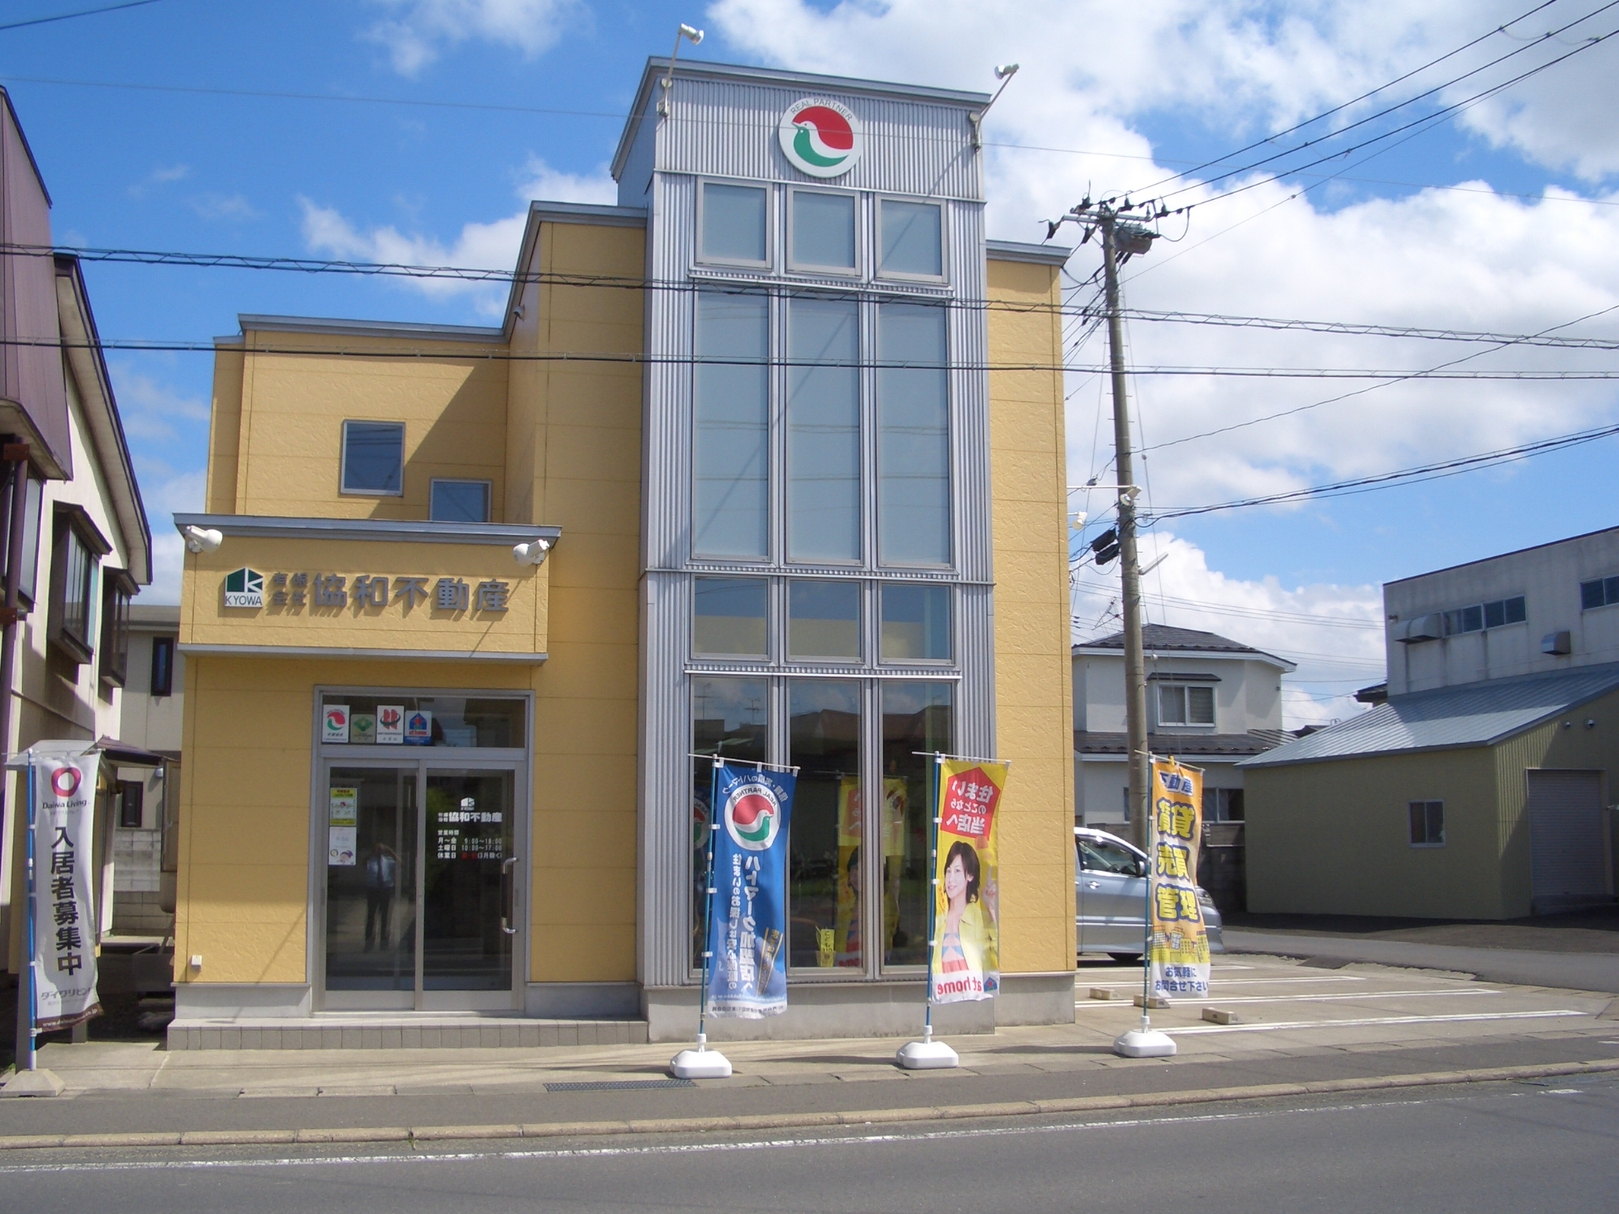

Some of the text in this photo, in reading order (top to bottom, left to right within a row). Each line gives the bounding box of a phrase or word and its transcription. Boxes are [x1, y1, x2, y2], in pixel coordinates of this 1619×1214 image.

[790, 98, 853, 121] REAL PARTNER
[273, 572, 308, 587] 有限
[272, 591, 307, 606] 会社
[315, 573, 509, 612] 協和不動産
[225, 595, 263, 606] KYOWA
[42, 799, 87, 810] Daiwa Living
[449, 811, 502, 822] 協和不動産
[1157, 799, 1195, 839] 賃貸
[1157, 844, 1190, 881] 売買
[51, 827, 82, 976] 入居者募集中
[1156, 885, 1199, 922] 管理
[1165, 966, 1197, 978] お気軽に
[1155, 980, 1209, 992] お問合せ下さい
